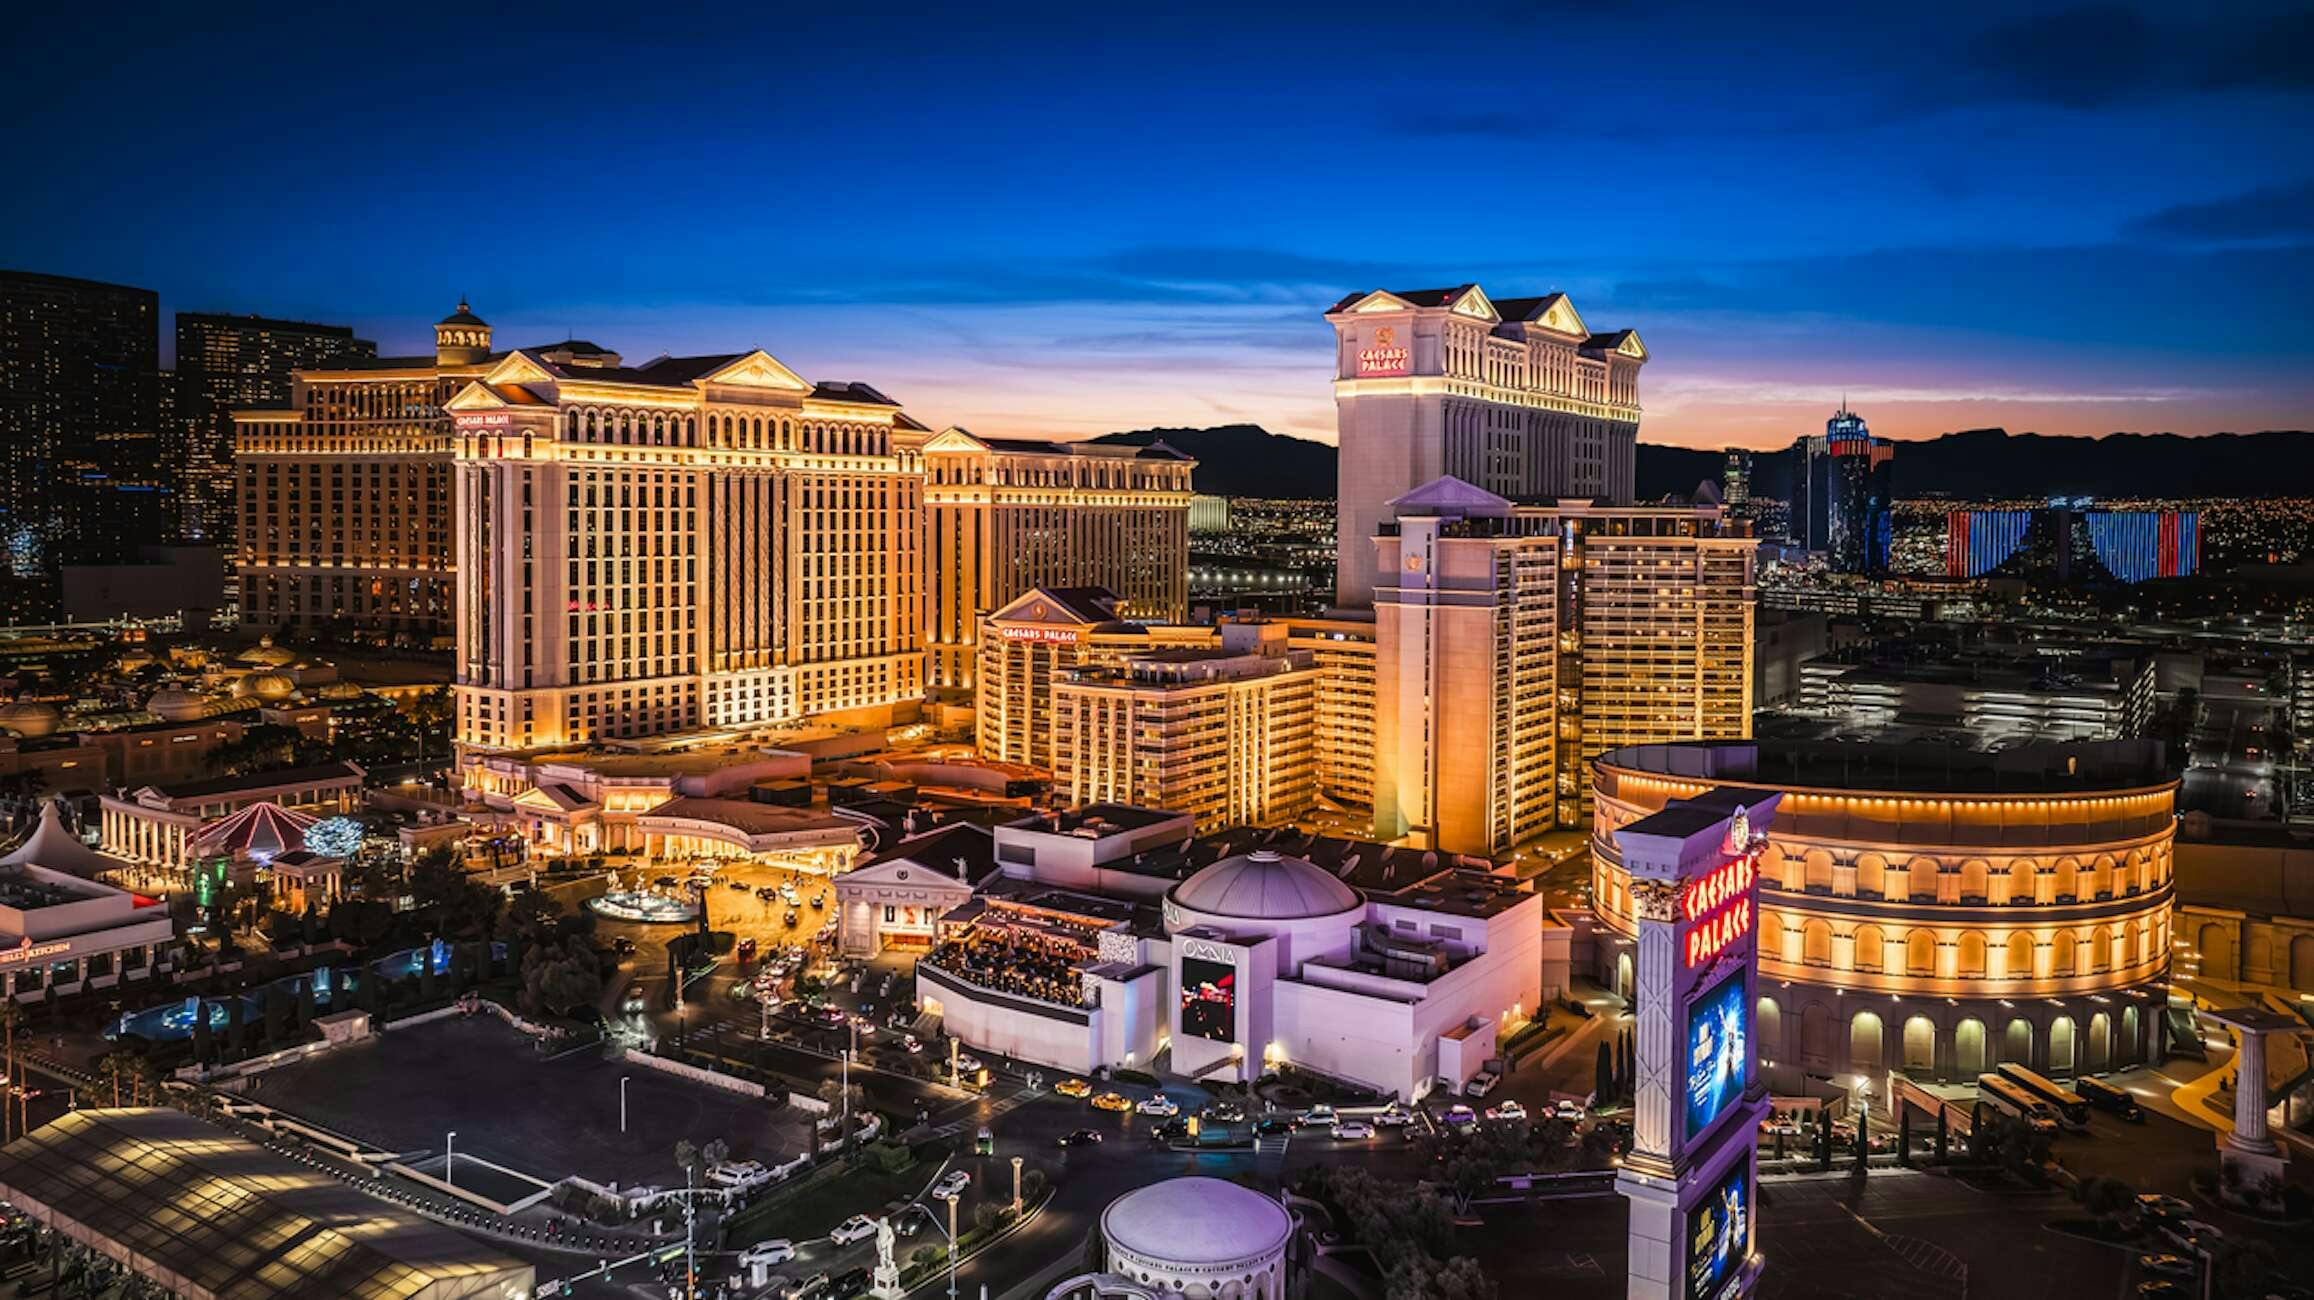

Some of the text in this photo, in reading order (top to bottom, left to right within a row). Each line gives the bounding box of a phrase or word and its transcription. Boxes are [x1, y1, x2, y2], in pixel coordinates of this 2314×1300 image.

[1360, 349, 1408, 360] CAESARS
[1361, 360, 1405, 371] PALACE
[1003, 628, 1077, 641] CAESARS PALACE
[1685, 854, 1754, 921] CAESARS
[1687, 897, 1750, 968] PALACE
[1183, 939, 1237, 965] OMNIA
